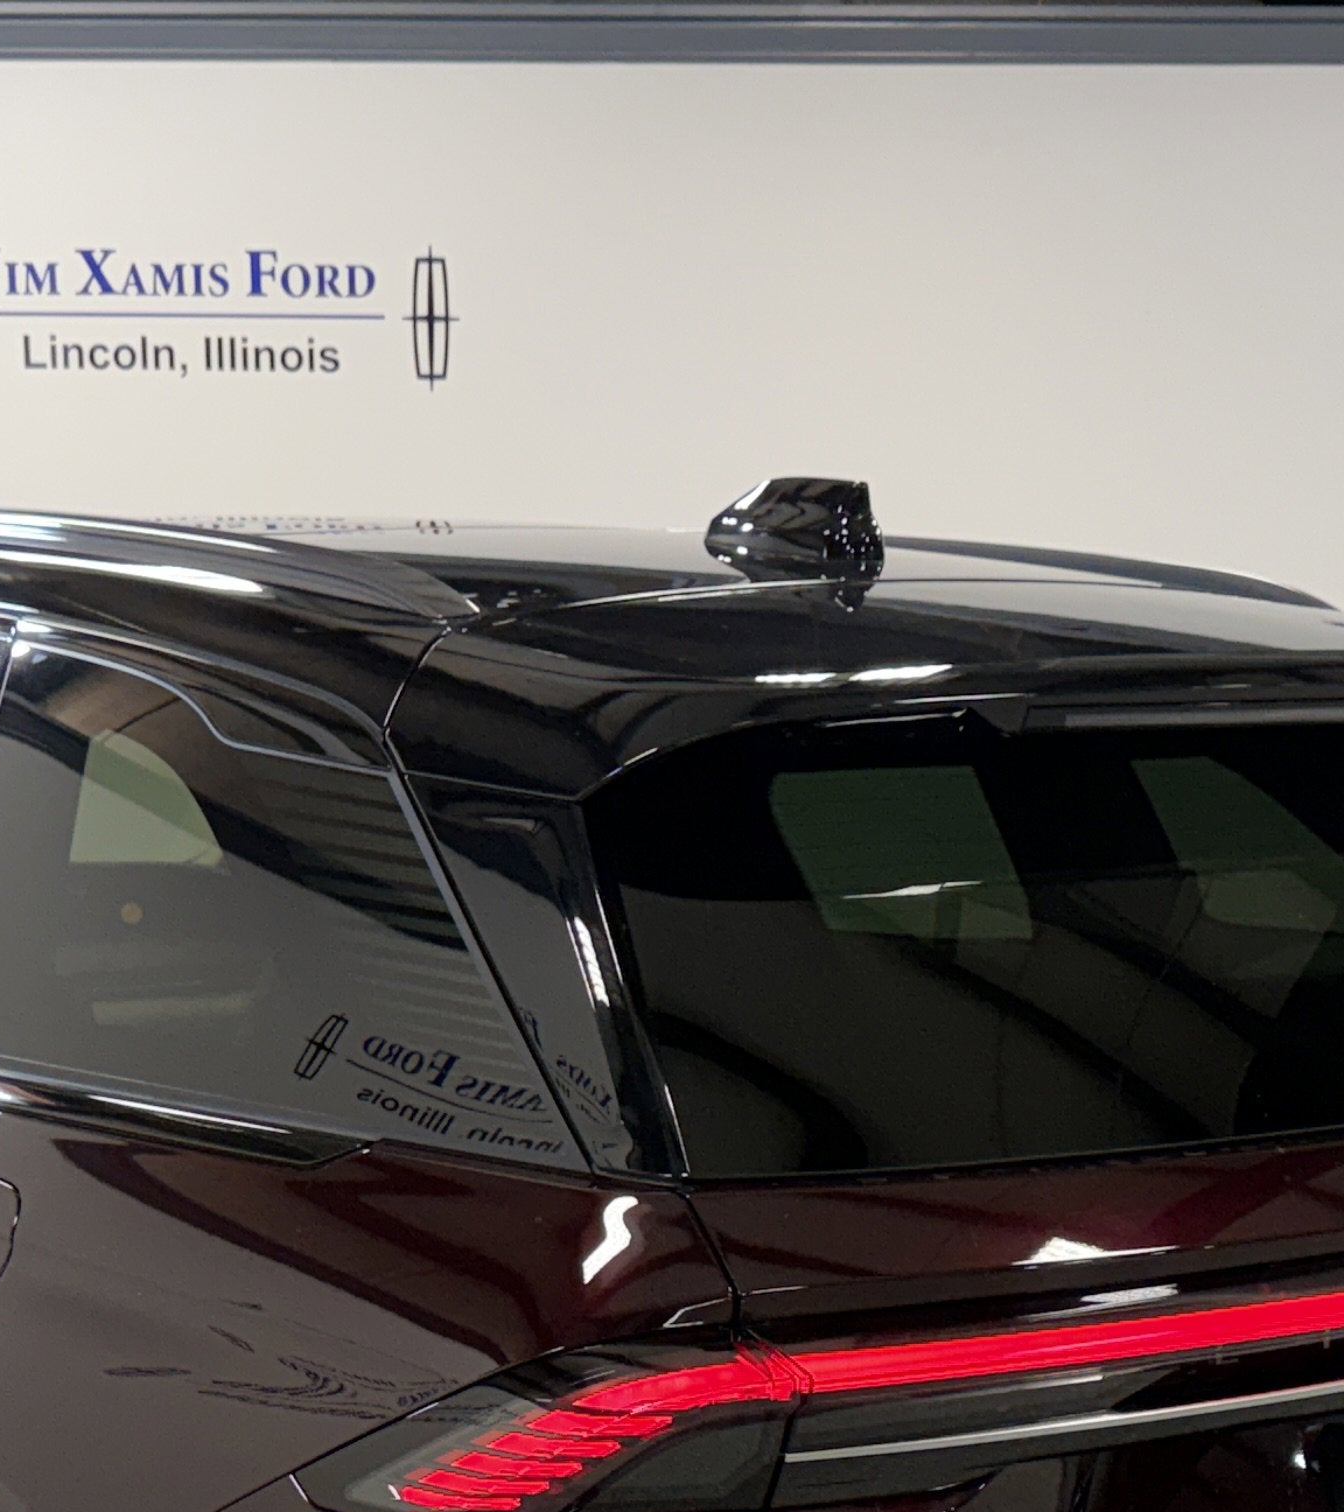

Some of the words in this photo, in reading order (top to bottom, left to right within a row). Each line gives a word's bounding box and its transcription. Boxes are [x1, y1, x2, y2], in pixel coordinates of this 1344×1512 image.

[73, 248, 230, 299] XAMIS
[244, 249, 377, 299] FORD
[22, 335, 189, 378] Lincoln,
[203, 336, 342, 374] Illinois
